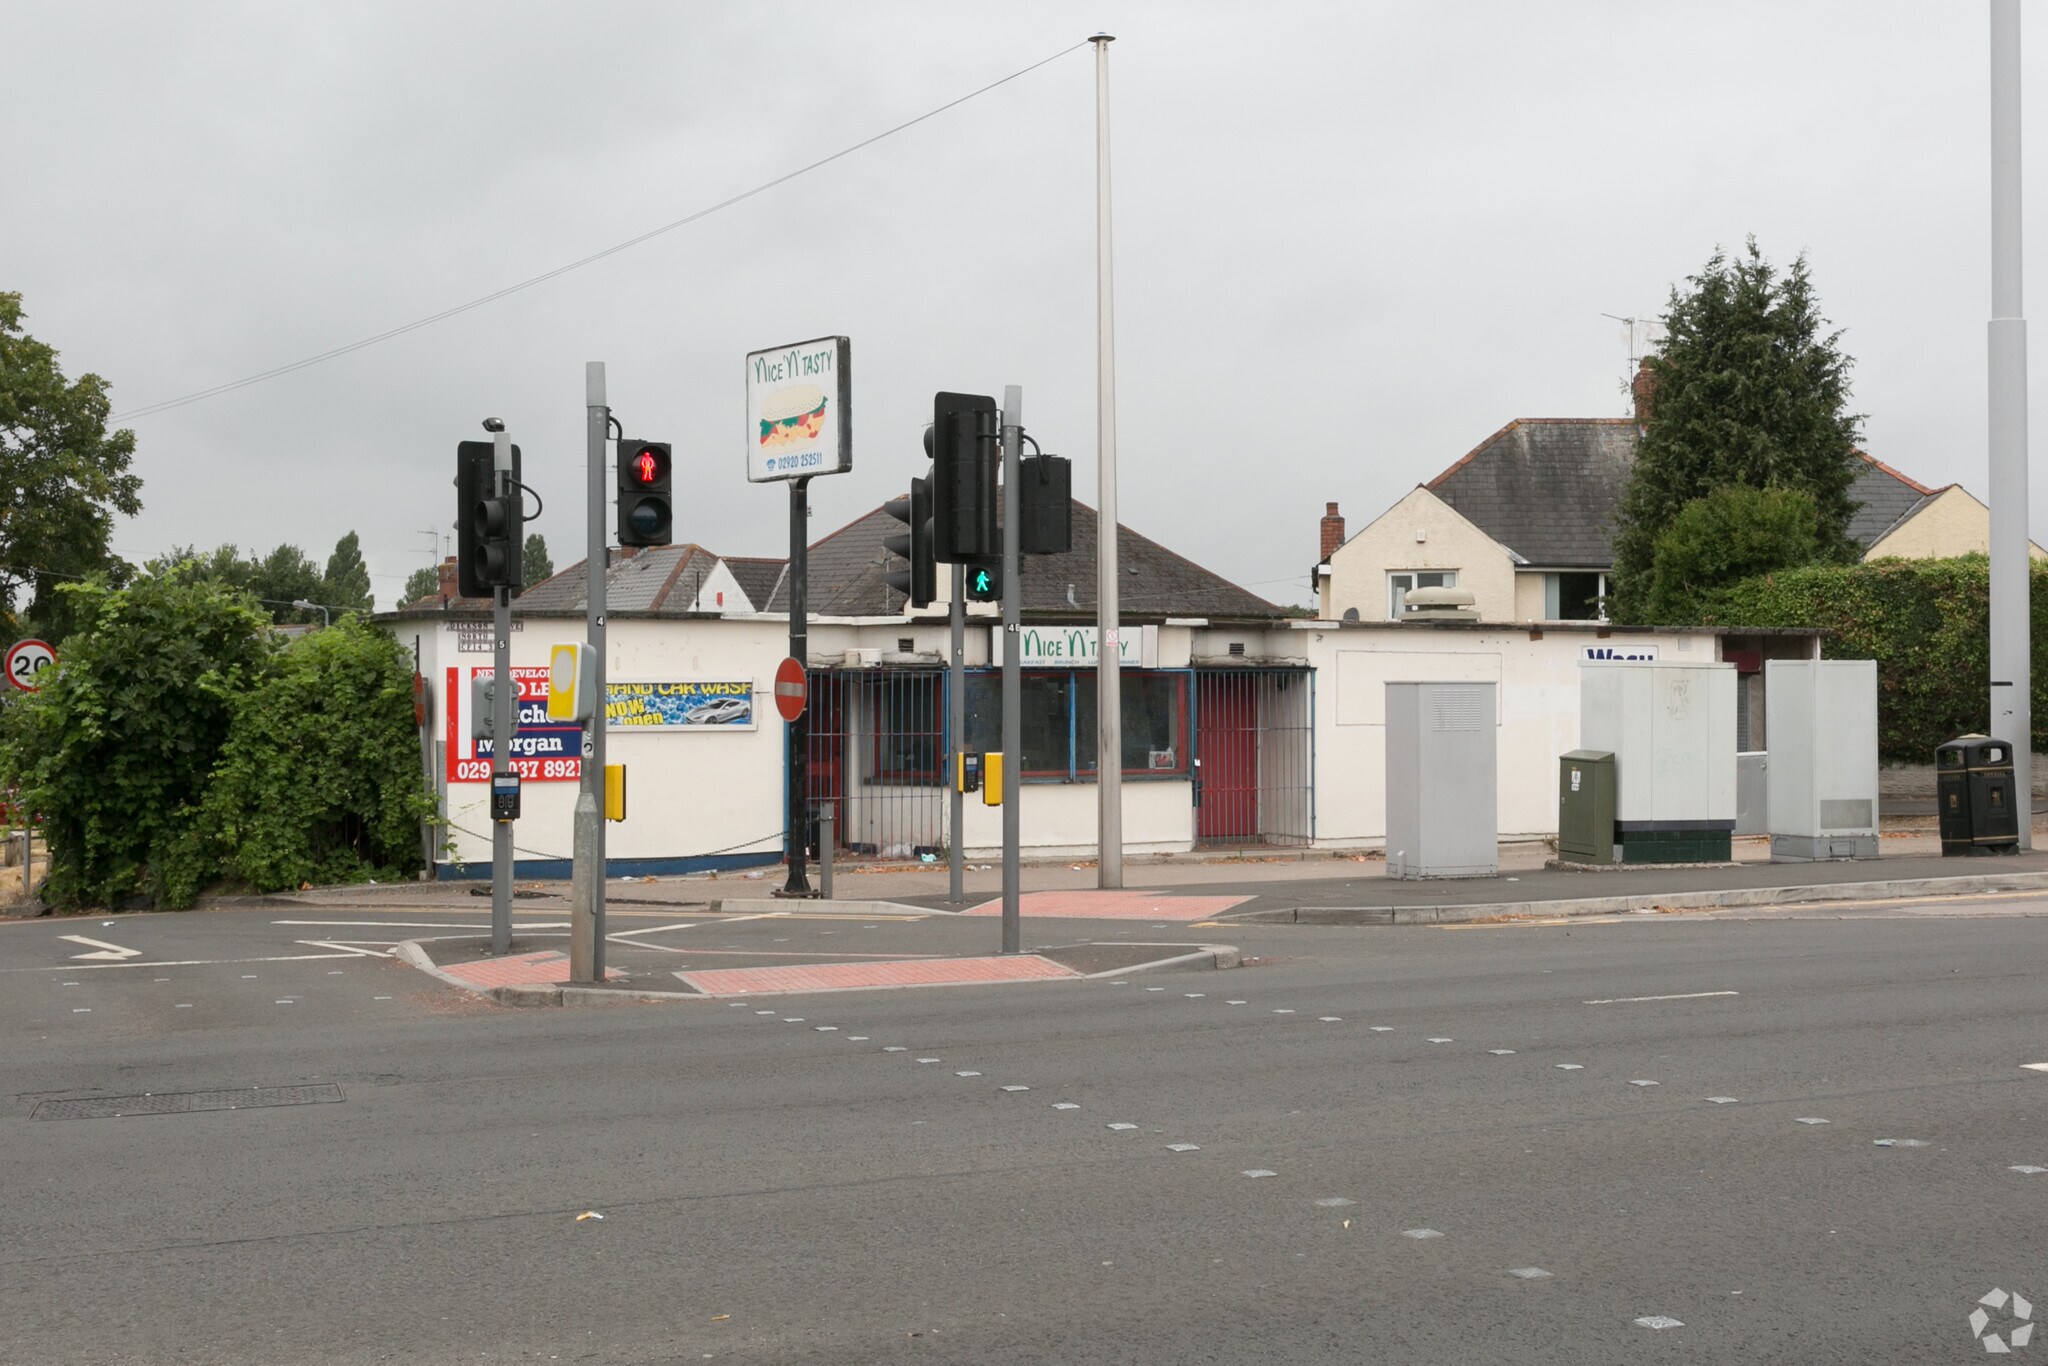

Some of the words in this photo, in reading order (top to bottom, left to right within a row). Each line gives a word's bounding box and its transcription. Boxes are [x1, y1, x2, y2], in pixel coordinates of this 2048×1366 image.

[755, 357, 783, 383] NICE
[802, 349, 832, 376] TASTY
[597, 617, 604, 626] 4
[1023, 630, 1062, 657] NICE
[15, 656, 51, 675] 20
[457, 762, 490, 779] 029
[509, 761, 539, 777] 037
